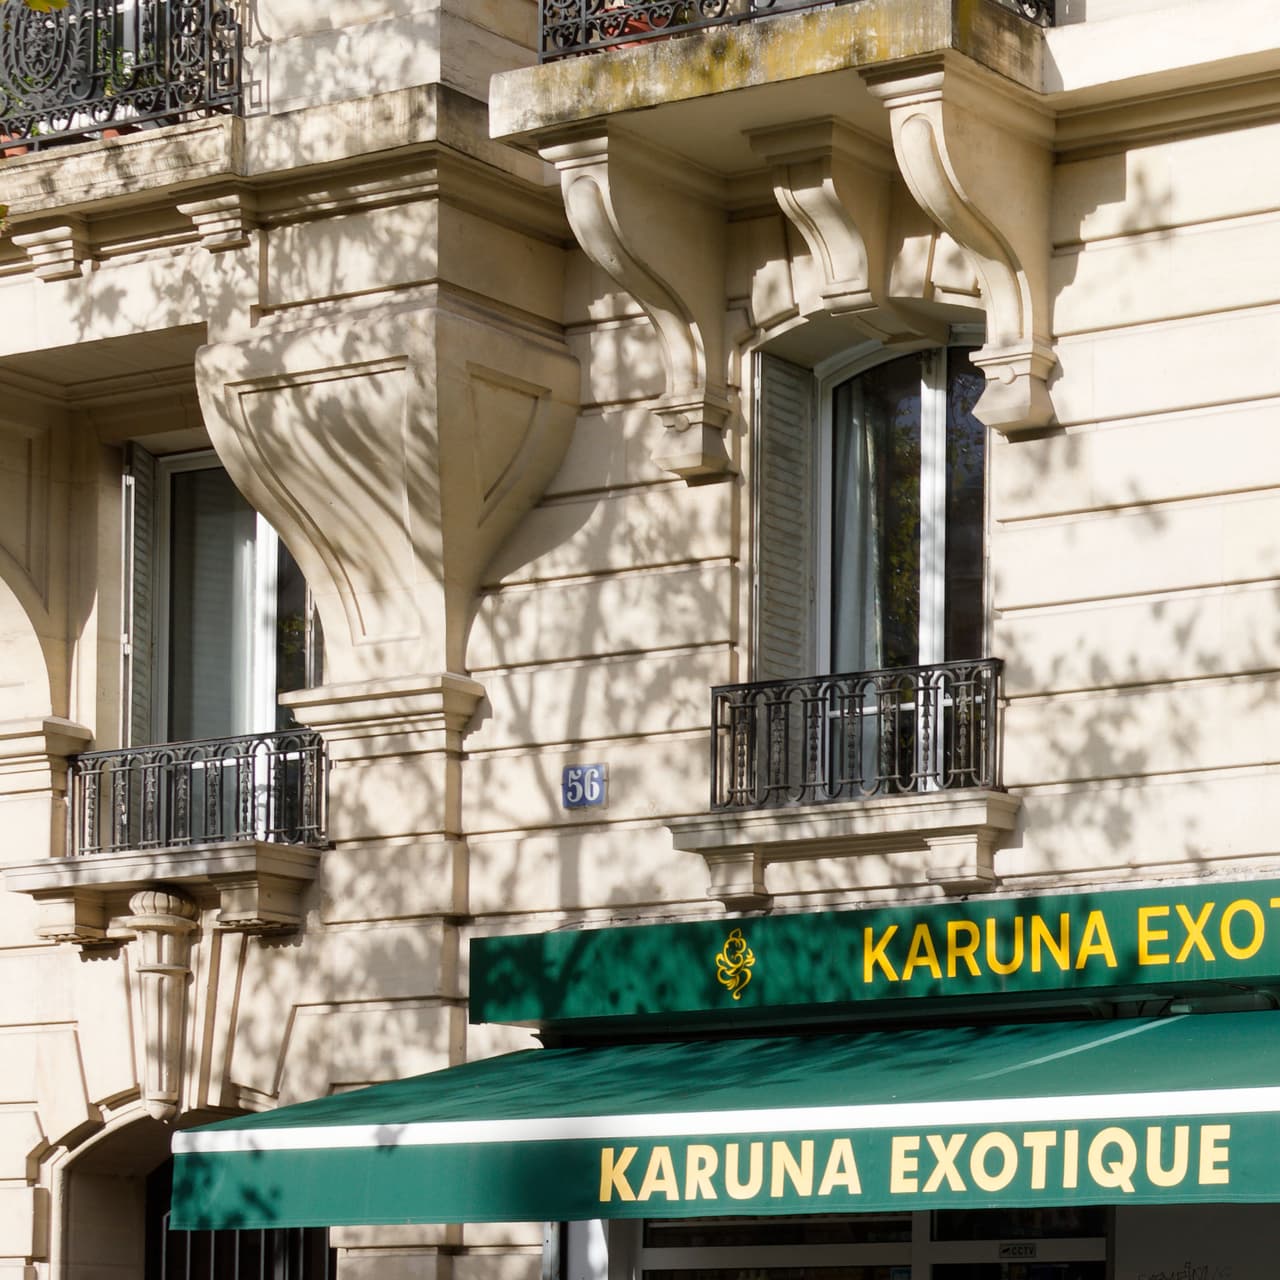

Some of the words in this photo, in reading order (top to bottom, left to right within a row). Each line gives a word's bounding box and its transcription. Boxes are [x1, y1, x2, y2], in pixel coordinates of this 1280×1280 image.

[566, 768, 600, 803] 56
[863, 910, 1117, 983] KARUNA
[599, 1138, 861, 1202] KARUNA
[889, 1124, 1231, 1194] EXOTIQUE
[1011, 1246, 1035, 1256] CCTV
